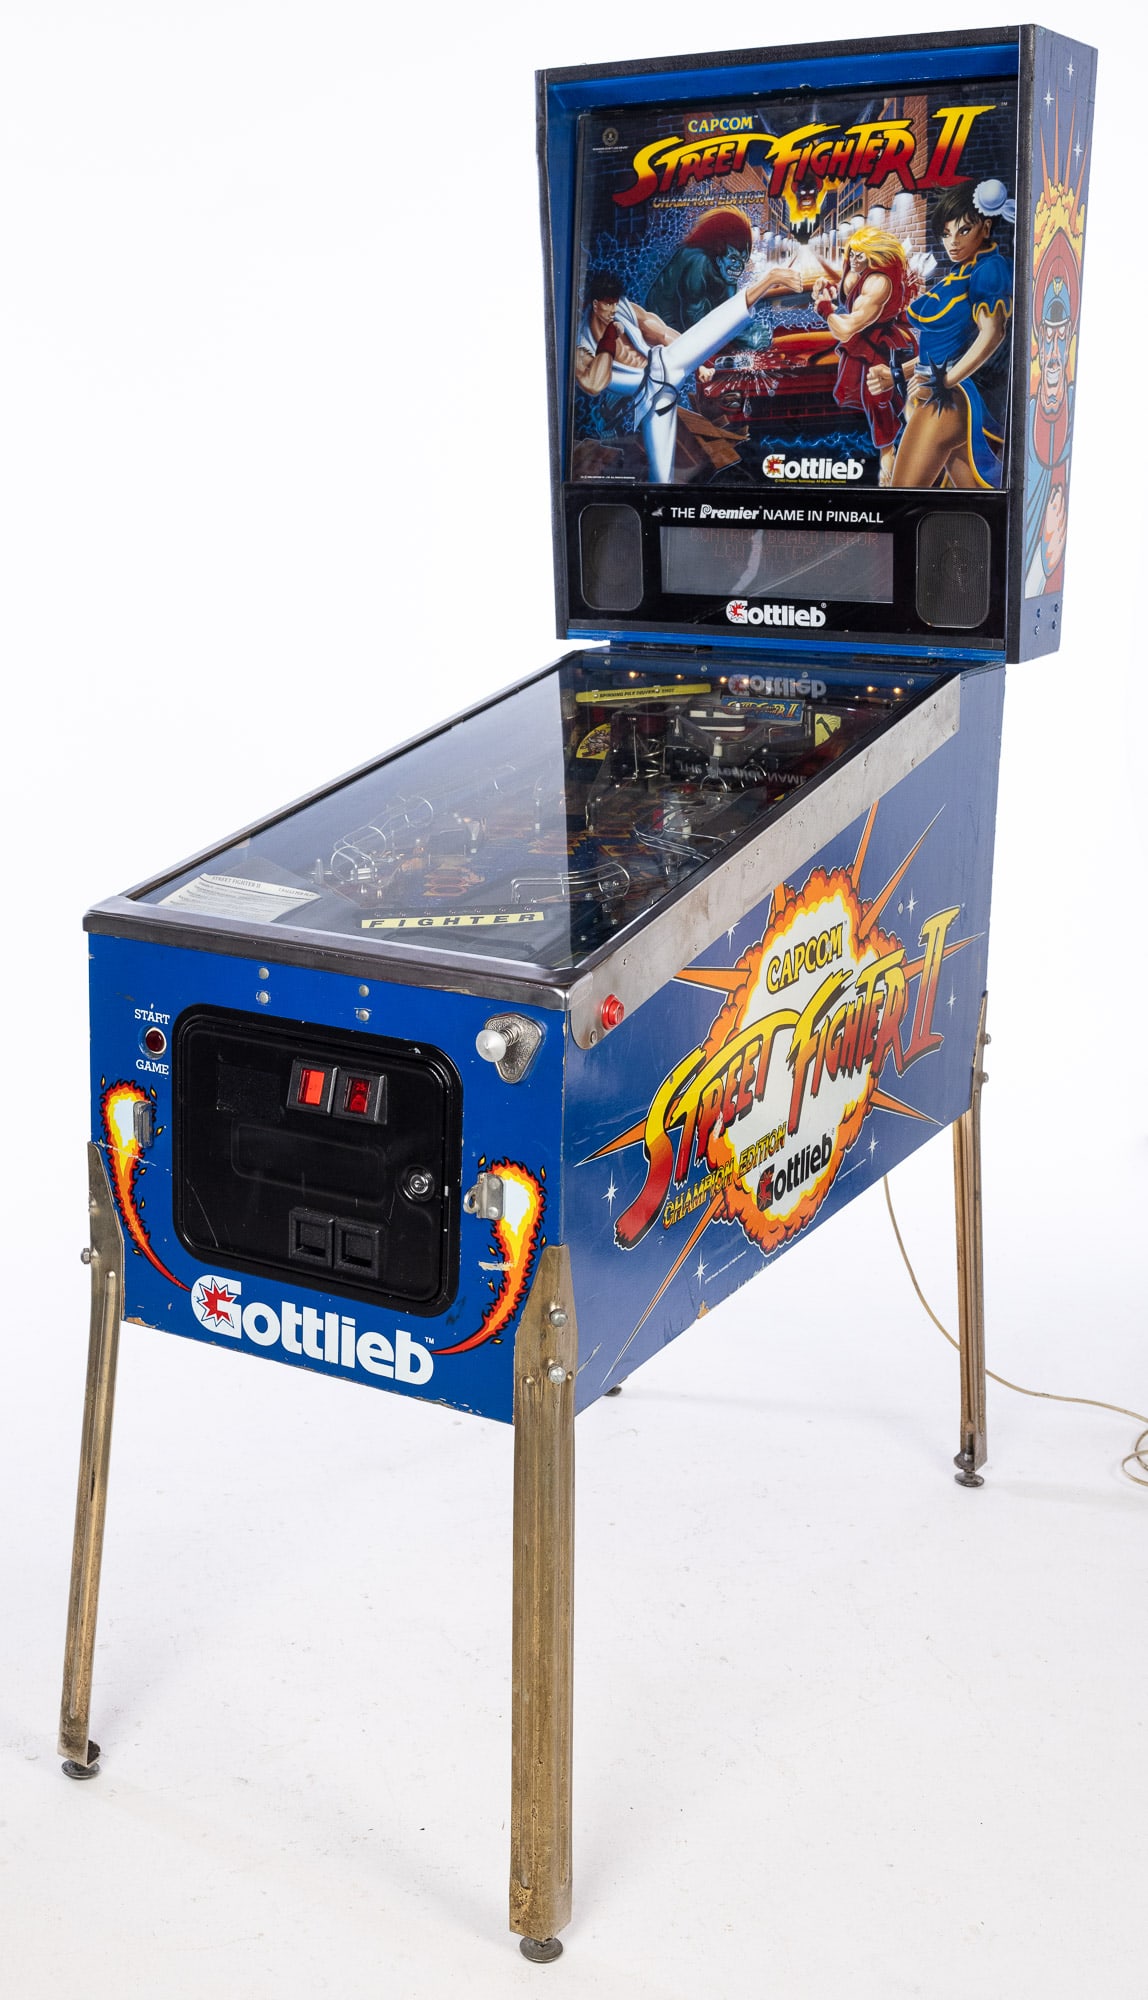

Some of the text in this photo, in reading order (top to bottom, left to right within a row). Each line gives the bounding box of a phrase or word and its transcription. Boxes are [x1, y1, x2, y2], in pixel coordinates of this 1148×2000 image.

[688, 116, 753, 133] CAPCOM
[612, 135, 768, 208] STREET
[766, 119, 920, 197] FIGHTER
[652, 190, 765, 208] CHAMPION EDITION
[762, 454, 864, 480] Gottlieb
[670, 504, 884, 523] THE Premier NAME IN PINBALL
[726, 600, 826, 627] Gottlieb
[766, 922, 843, 994] CAPCOM
[134, 1008, 171, 1025] START
[135, 1059, 169, 1075] GAME
[614, 1007, 800, 1251] STREET
[786, 948, 906, 1137] FIGHTER
[662, 1122, 787, 1231] CHAMPION EDITION
[757, 1133, 833, 1213] Gottlieb
[190, 1275, 434, 1385] Gottlieb
